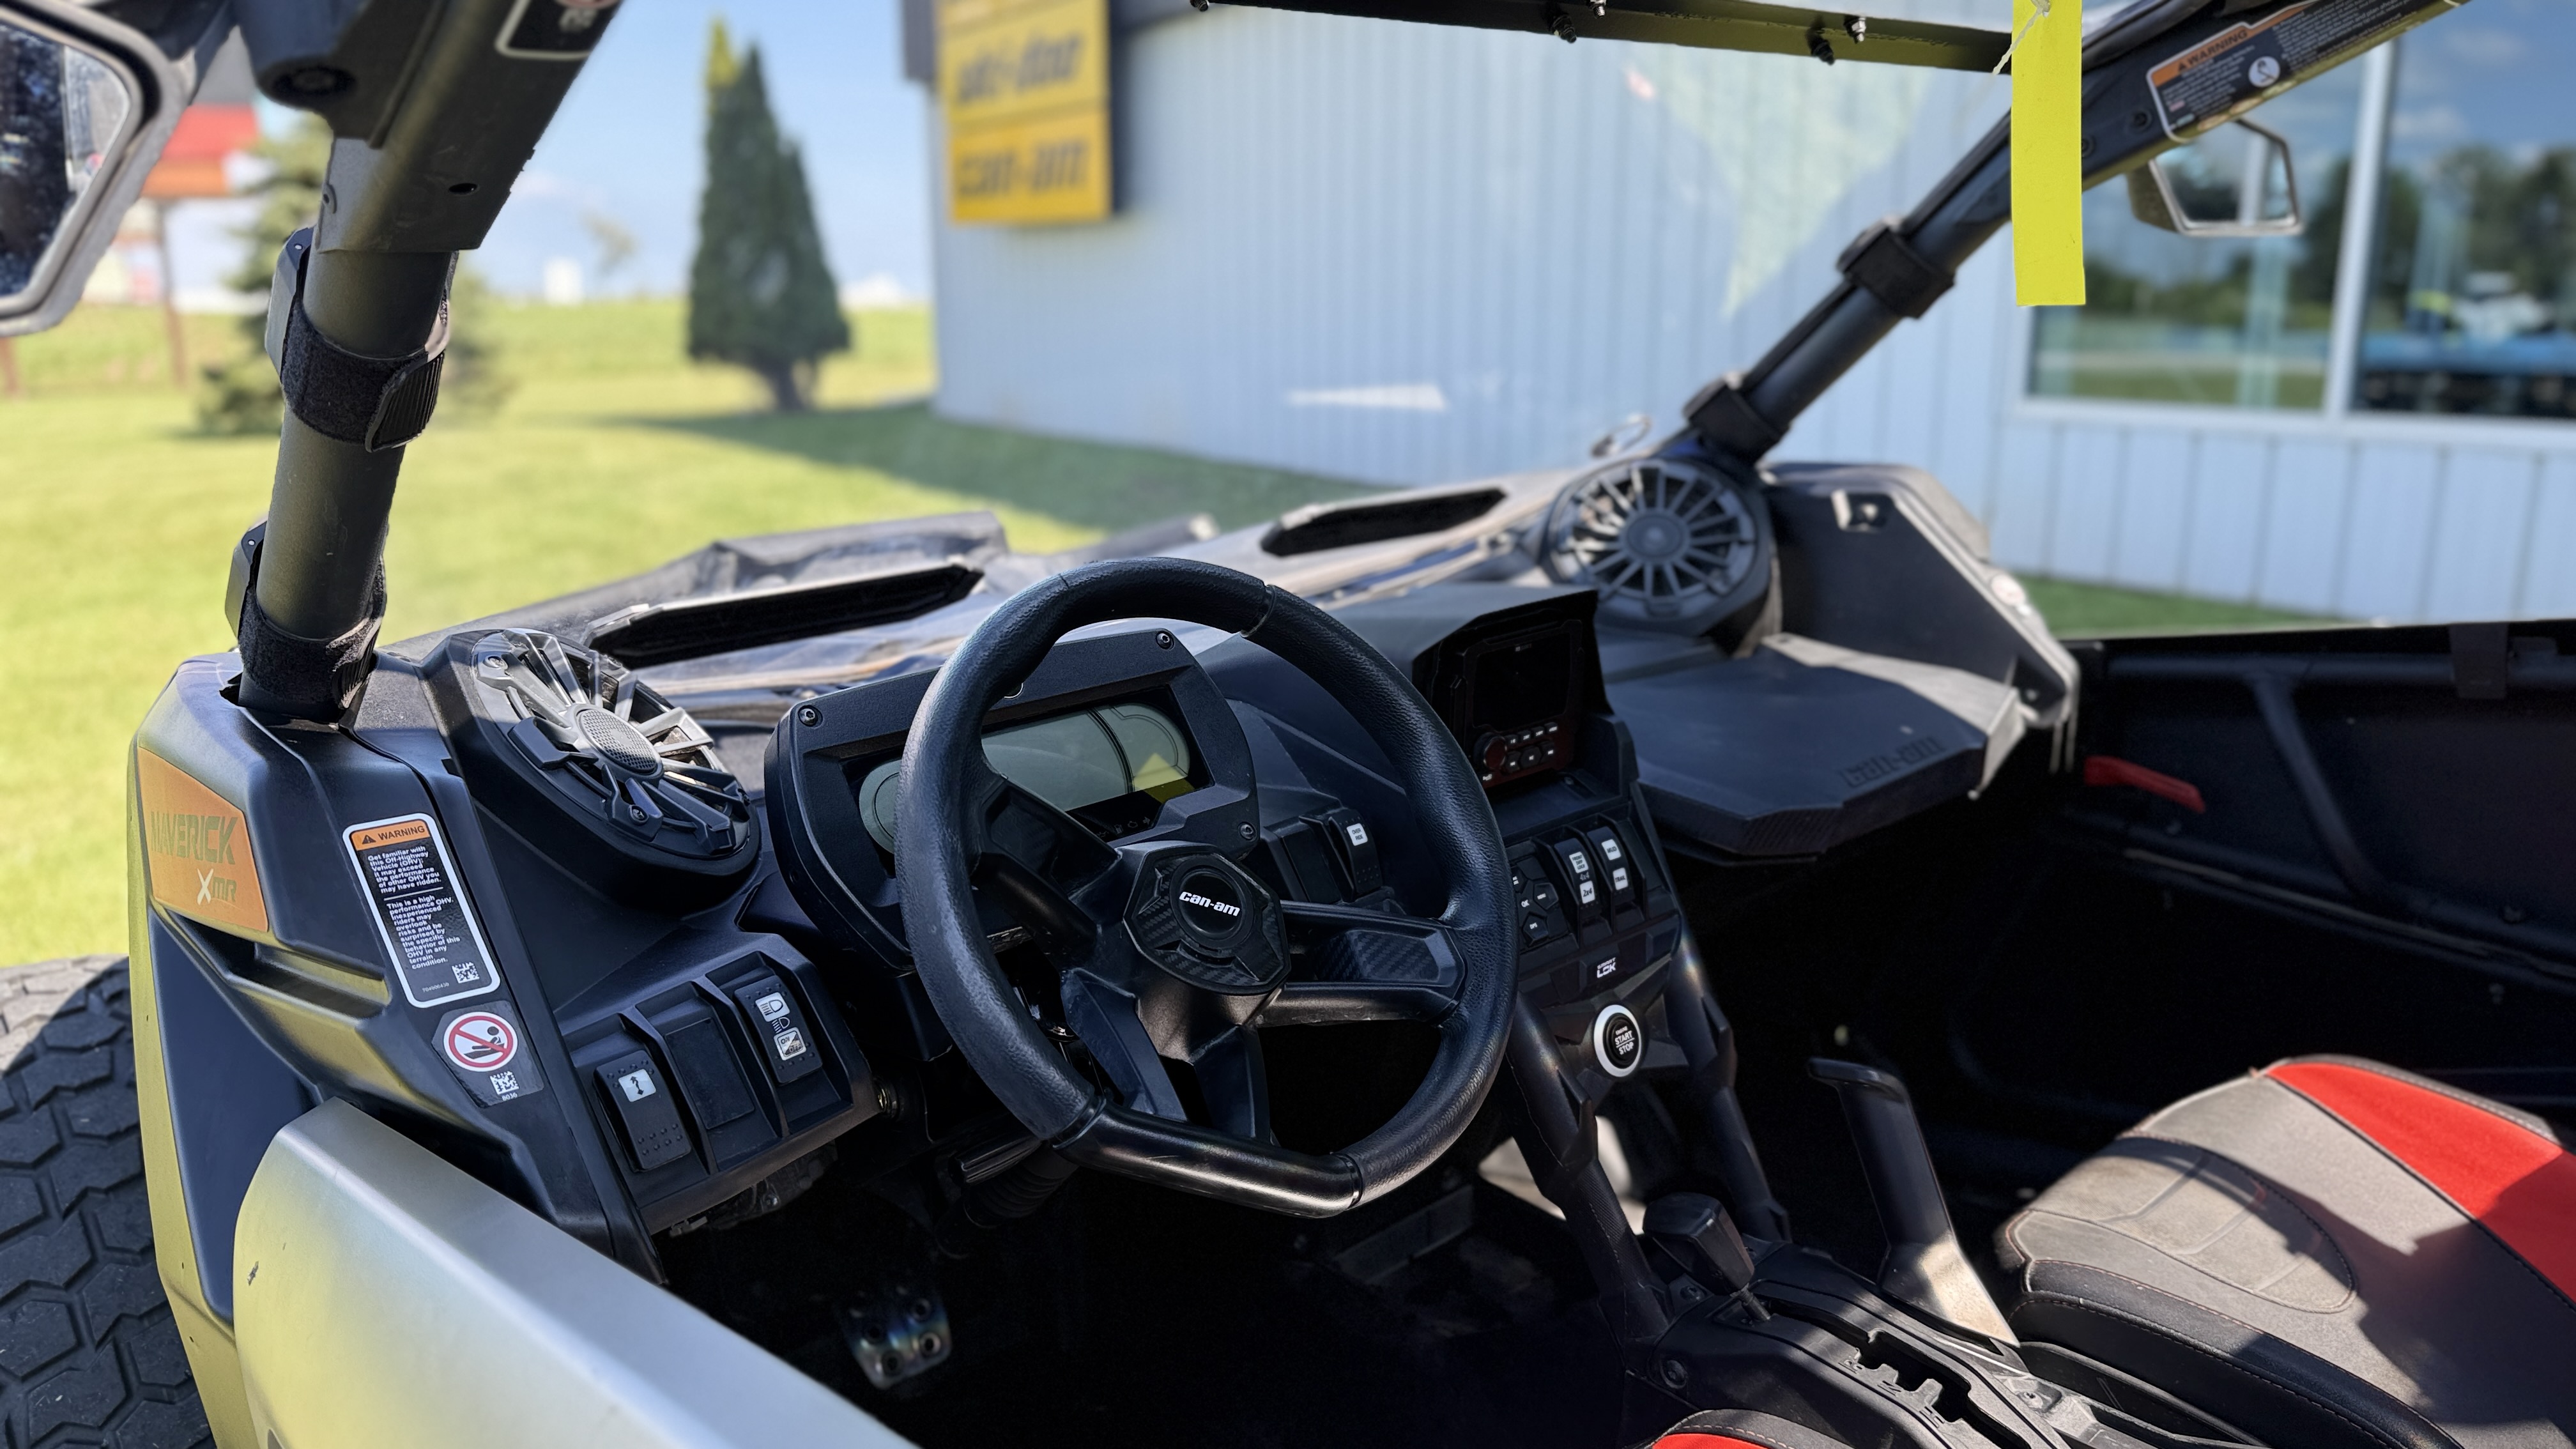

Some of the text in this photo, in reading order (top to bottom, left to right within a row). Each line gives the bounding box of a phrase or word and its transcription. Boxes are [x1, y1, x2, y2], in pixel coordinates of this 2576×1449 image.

[2188, 30, 2248, 65] WARNING
[1838, 737, 1947, 788] can-am
[151, 811, 238, 864] MAVERICK
[378, 825, 425, 840] WARNING
[382, 849, 410, 859] familiar
[410, 845, 426, 854] with
[385, 852, 429, 864] Off-Highway
[372, 863, 399, 872] Vehicle
[397, 863, 424, 873] exceed
[388, 878, 407, 886] other
[425, 871, 440, 882] you
[390, 868, 434, 882] performance
[1579, 871, 1590, 881] 4x4
[397, 882, 415, 891] have
[416, 877, 442, 887] ridden.
[1583, 887, 1593, 898] 2x4
[387, 901, 404, 910] This
[418, 894, 436, 903] high
[389, 896, 454, 916] performance OHV.
[1179, 891, 1241, 917] can-am
[1521, 900, 1530, 908] OK
[394, 917, 415, 926] riders
[395, 920, 428, 931] overlook
[398, 928, 417, 937] risks
[417, 924, 432, 933] and
[400, 930, 435, 942] surprised
[404, 942, 436, 953] behavior
[446, 936, 461, 944] this
[416, 934, 444, 945] specific
[407, 949, 423, 958] OHV
[409, 954, 434, 964] terrain
[411, 957, 448, 970] condition.
[781, 1036, 790, 1045] ON
[1614, 1030, 1632, 1045] START
[788, 1044, 803, 1054] OFF
[1618, 1041, 1634, 1055] STOP
